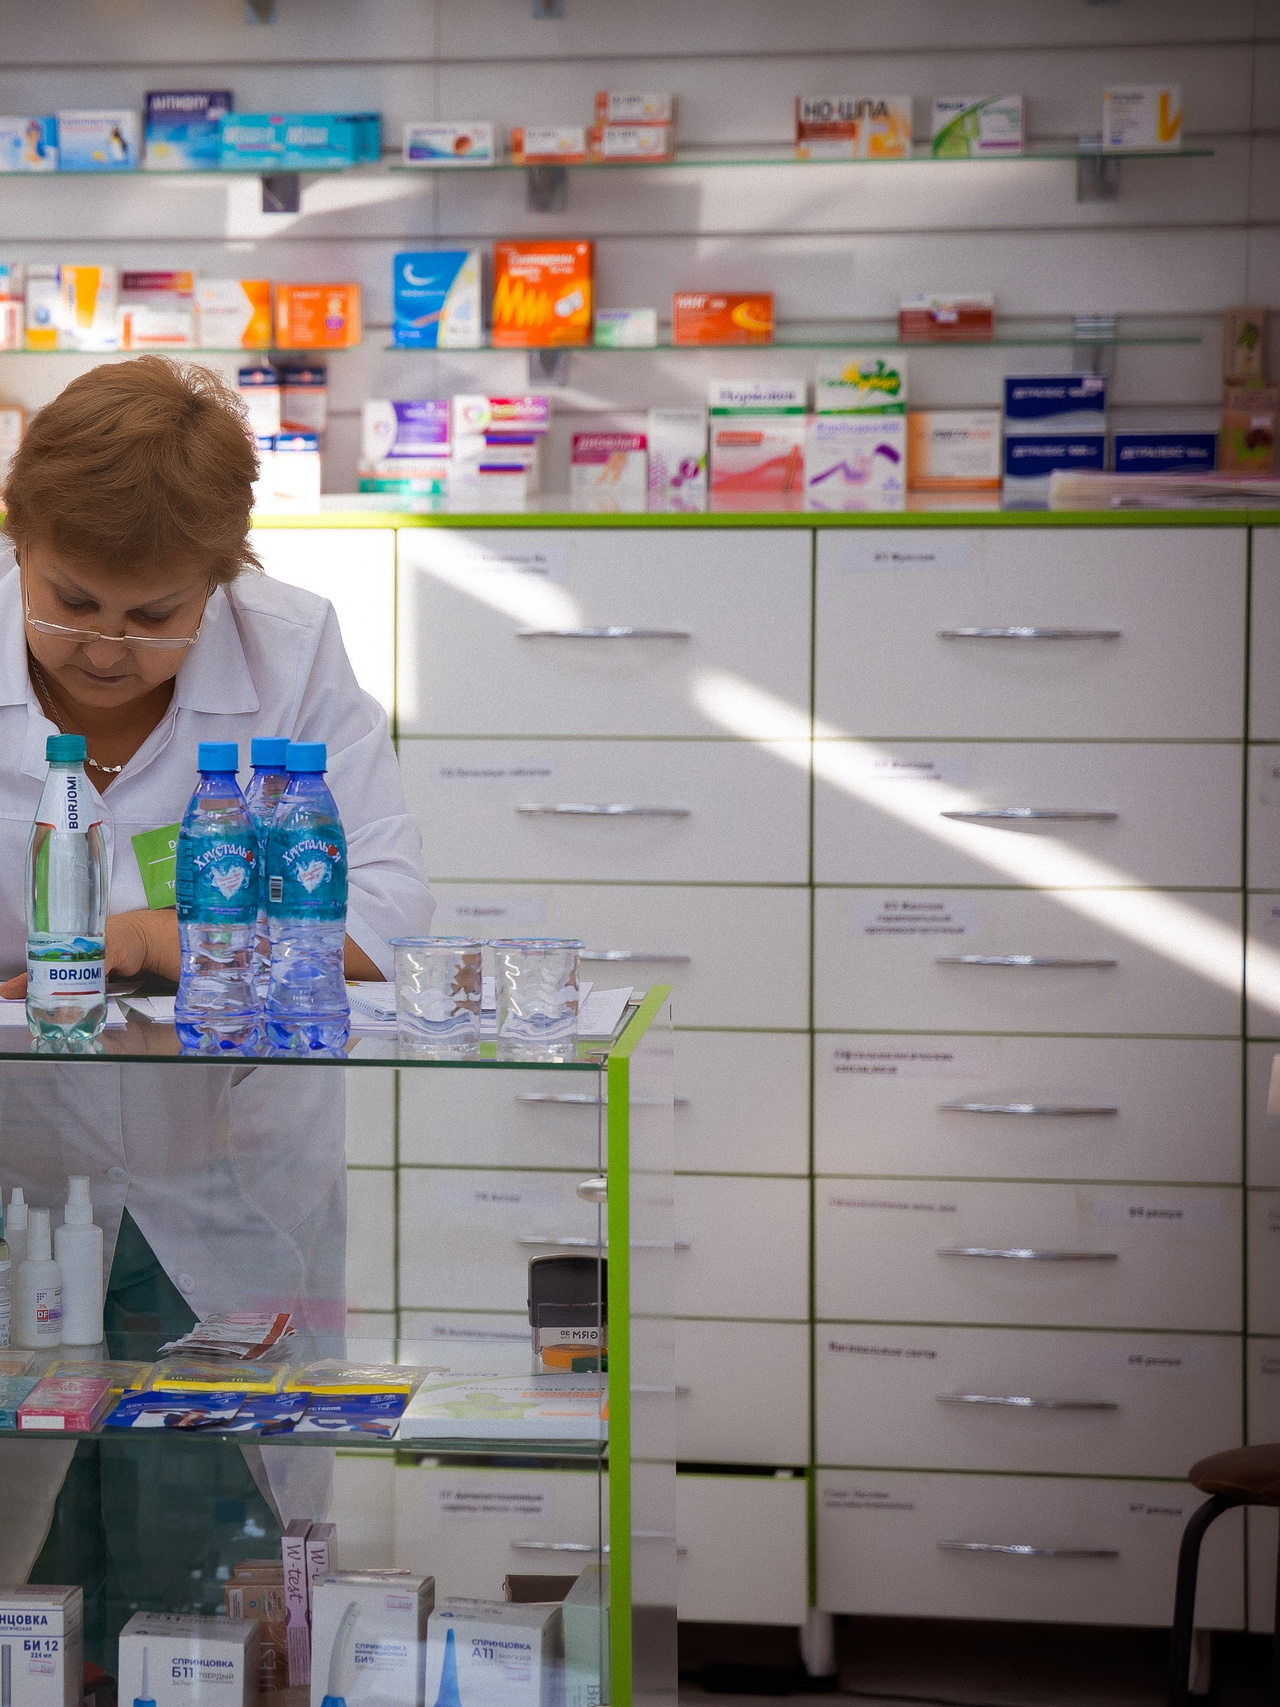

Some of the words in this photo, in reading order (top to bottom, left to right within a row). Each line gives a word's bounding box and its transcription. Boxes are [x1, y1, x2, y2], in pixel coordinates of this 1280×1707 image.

[66, 776, 79, 830] BORJOMI
[49, 967, 102, 981] BORJOMI
[37, 1310, 48, 1319] DF
[286, 1543, 304, 1604] W-test
[23, 1639, 41, 1651] БИ
[44, 1640, 59, 1652] 12
[355, 1642, 407, 1651] СПРИНЦОВКА
[471, 1638, 532, 1651] СПРИНЦОВКА
[471, 1648, 494, 1660] А11
[171, 1657, 234, 1669] СПРИНЦОВКА
[171, 1667, 194, 1678] Б11
[198, 1672, 234, 1681] ТВЕРДЫЙ
